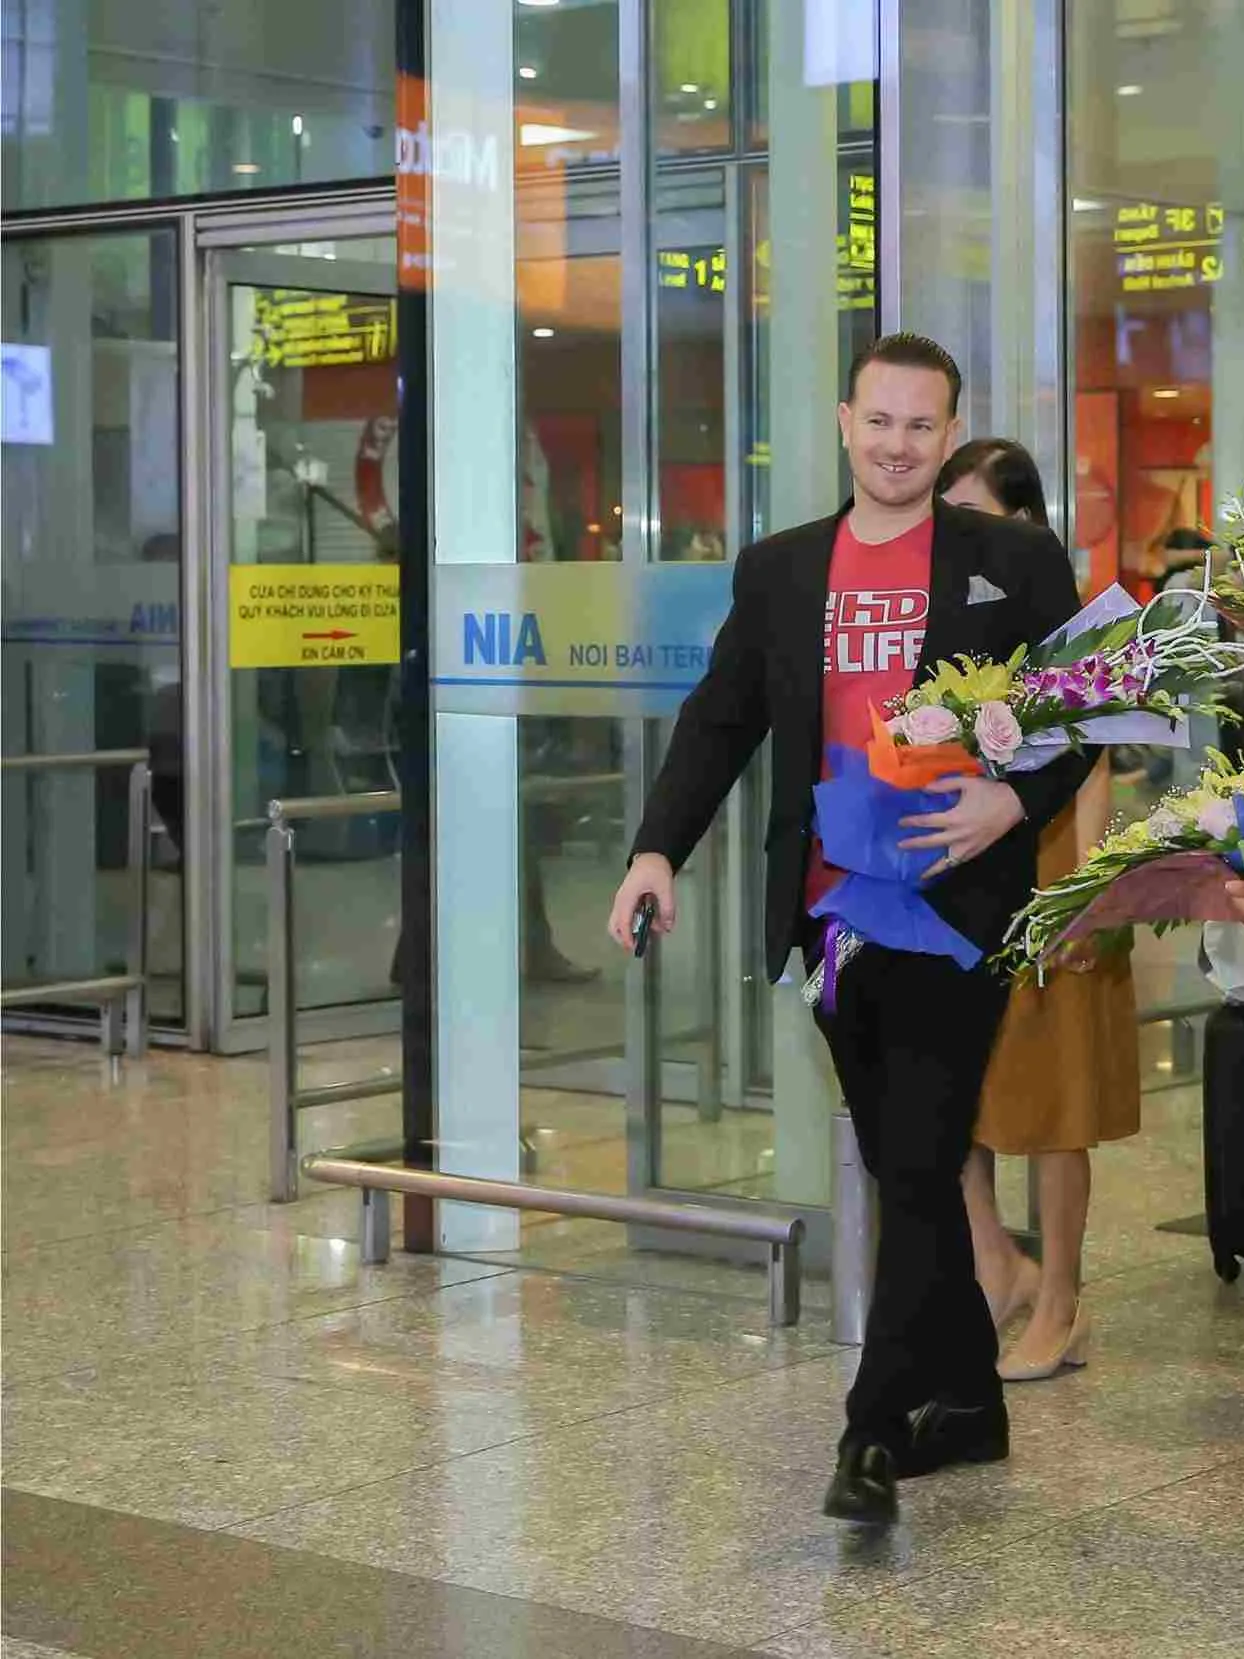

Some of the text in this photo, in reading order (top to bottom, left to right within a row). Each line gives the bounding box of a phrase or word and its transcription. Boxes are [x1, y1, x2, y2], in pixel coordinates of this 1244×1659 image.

[694, 259, 707, 287] 1
[463, 613, 547, 665] NIA
[569, 644, 713, 668] NOI BAI TER
